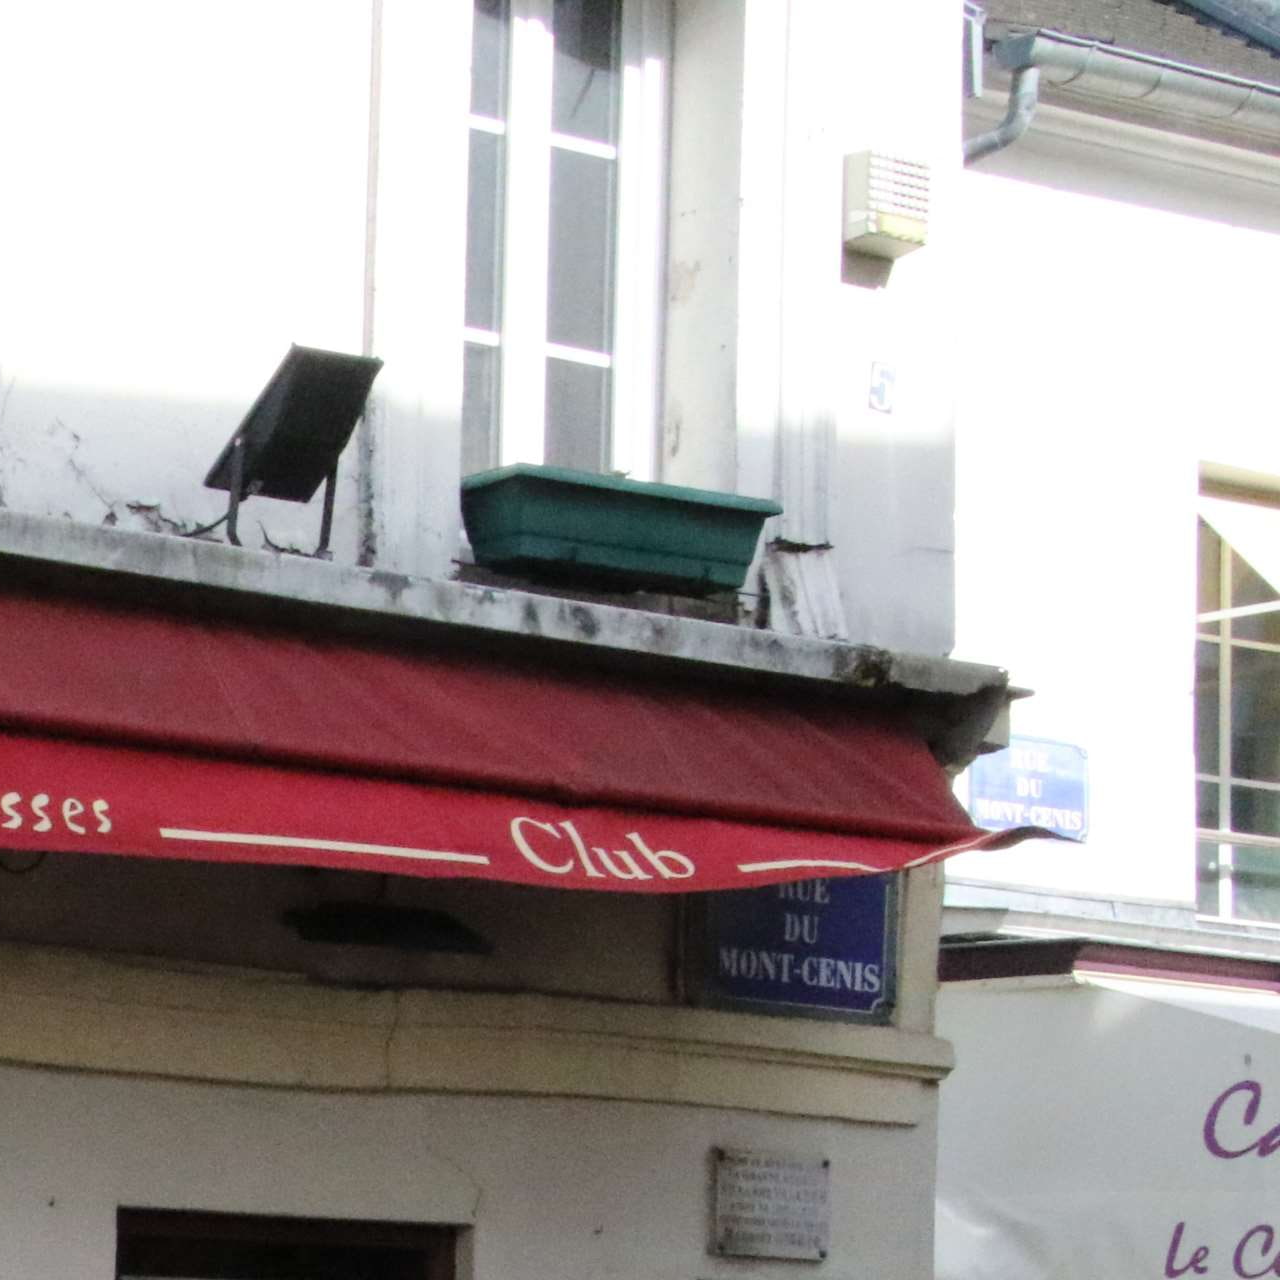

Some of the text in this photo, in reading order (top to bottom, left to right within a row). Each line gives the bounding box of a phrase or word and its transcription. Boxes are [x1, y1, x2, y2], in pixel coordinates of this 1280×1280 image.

[1016, 777, 1042, 798] DU
[976, 798, 1082, 831] MONT-CENIS
[510, 816, 696, 881] Club
[784, 913, 820, 944] DU
[719, 948, 881, 992] MONT-CENIS
